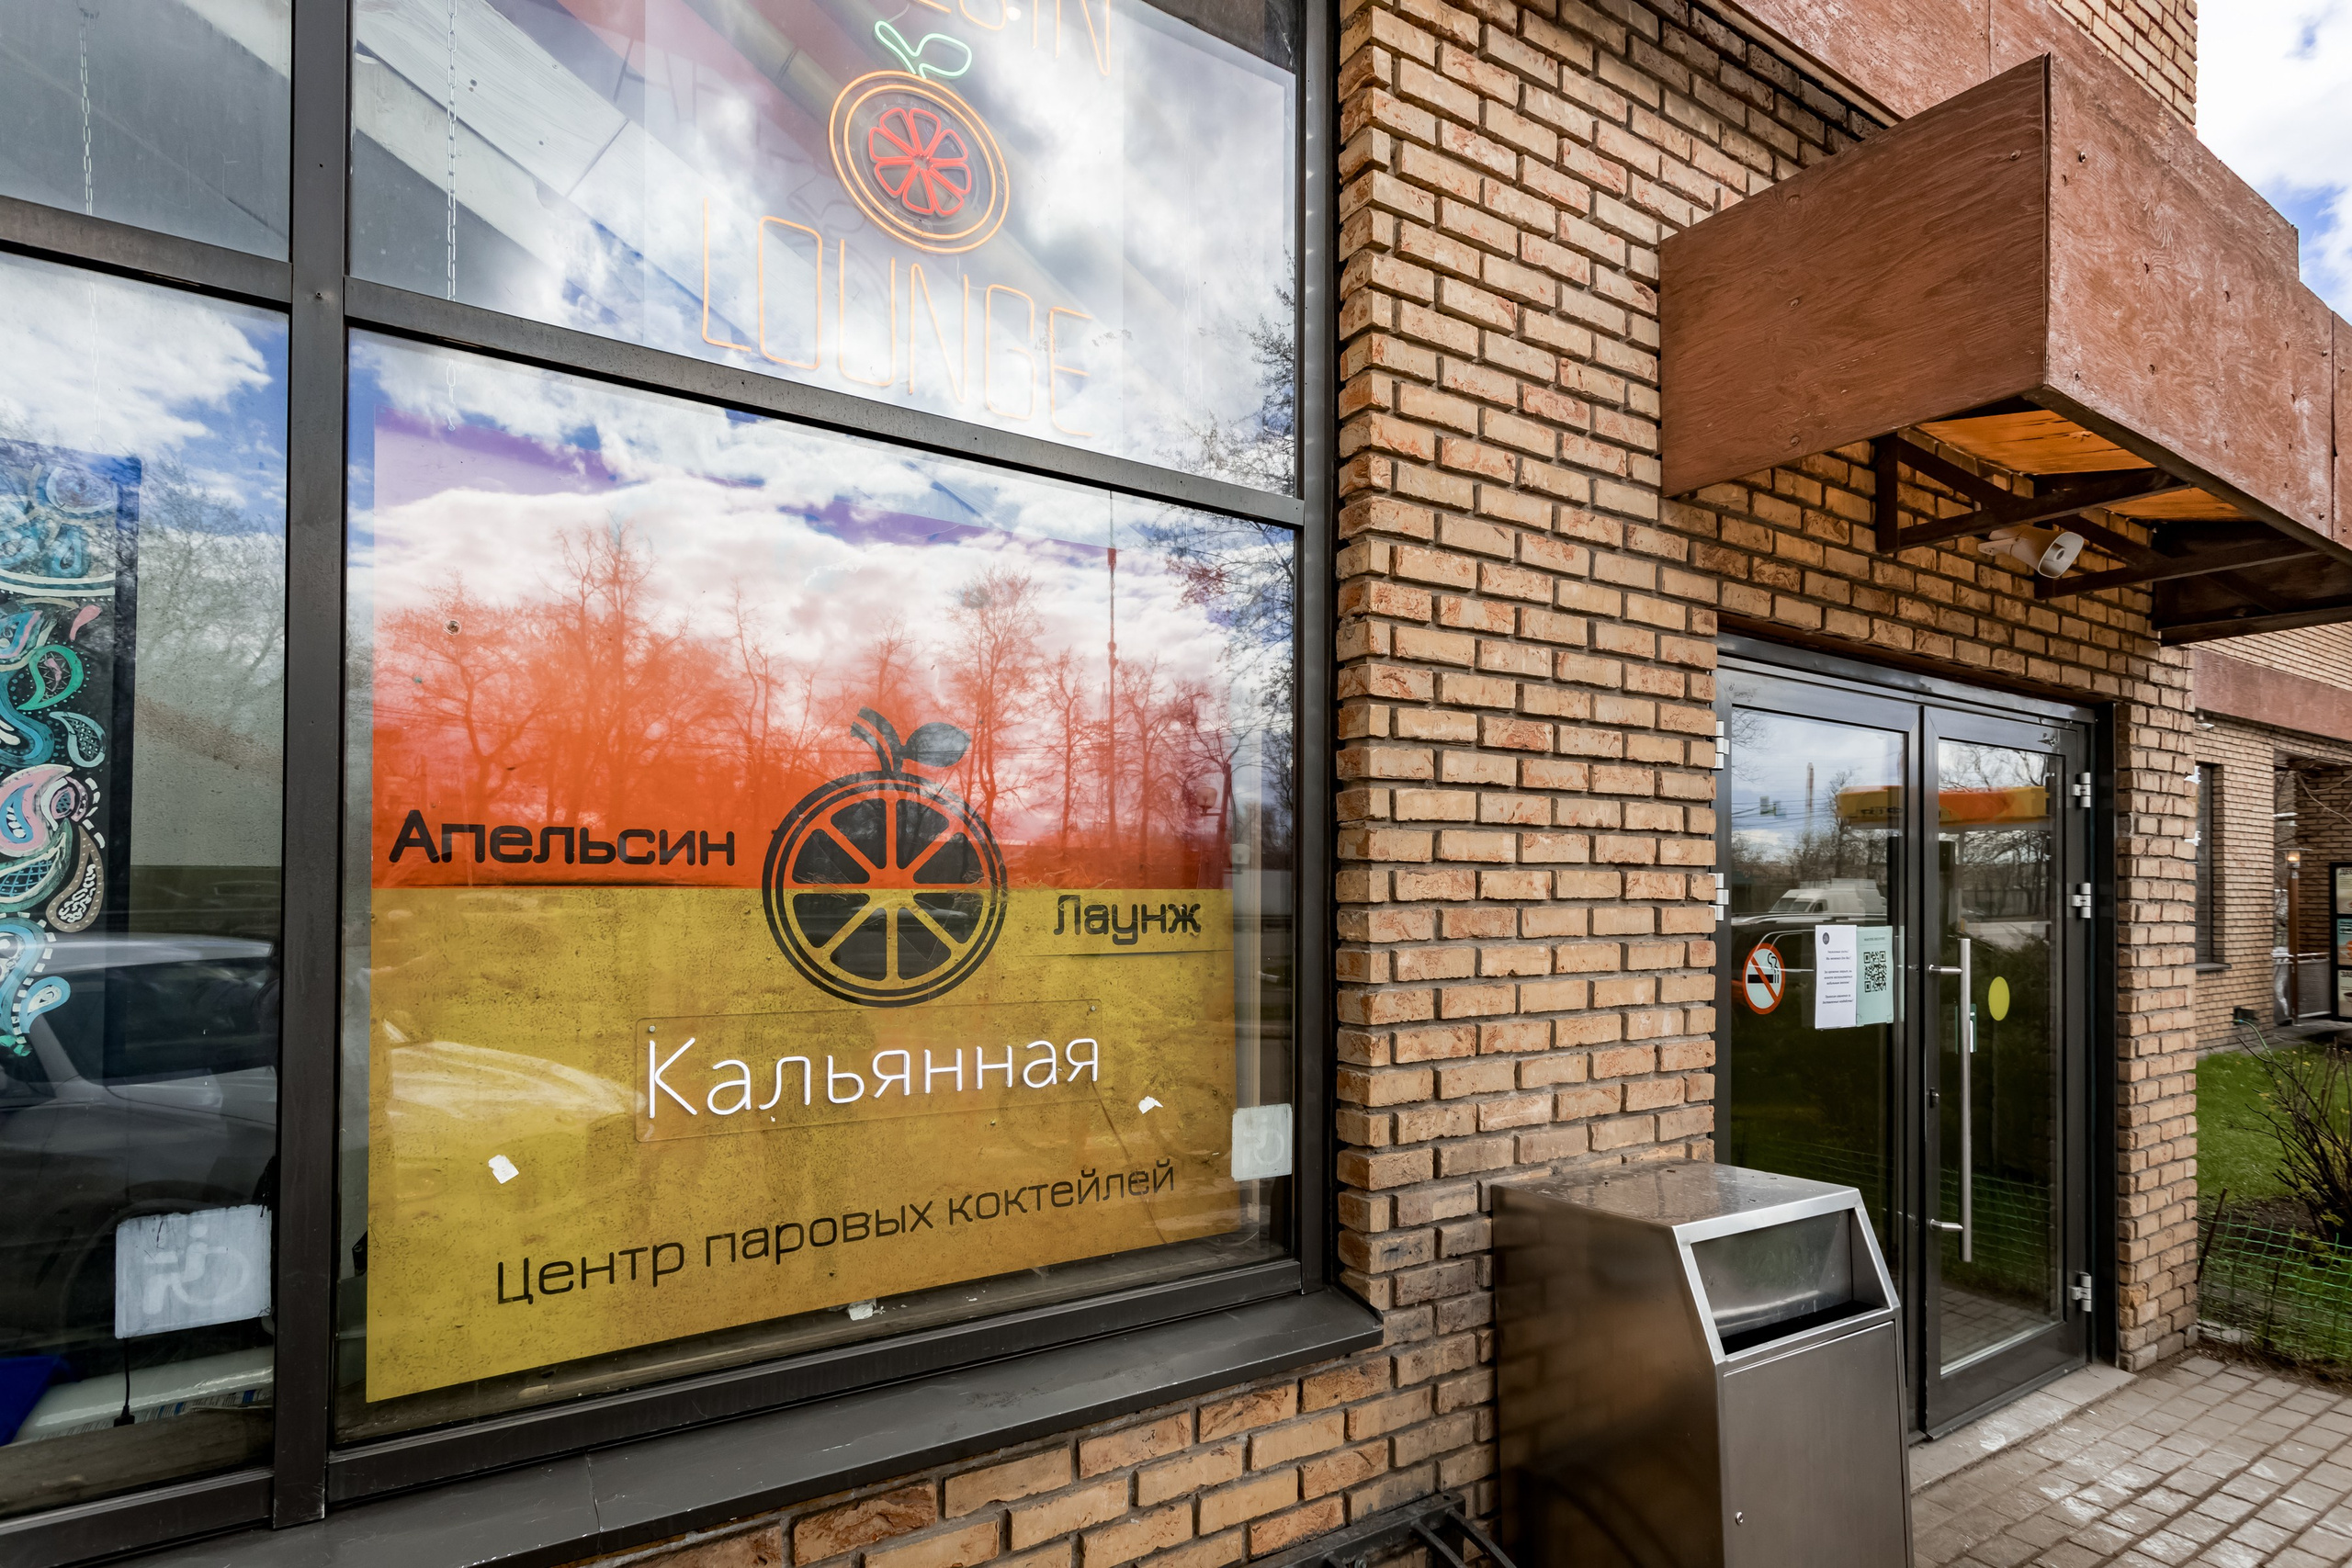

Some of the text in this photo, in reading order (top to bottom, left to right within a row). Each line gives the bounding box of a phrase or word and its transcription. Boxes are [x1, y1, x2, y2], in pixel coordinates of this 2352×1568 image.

[702, 197, 1092, 436] LOUNGE
[389, 809, 735, 865] Апельсин
[1053, 895, 1202, 945] Лаунж
[649, 1037, 1100, 1119] Кальянная
[498, 1159, 1175, 1304] Центр паровых коктейлей
